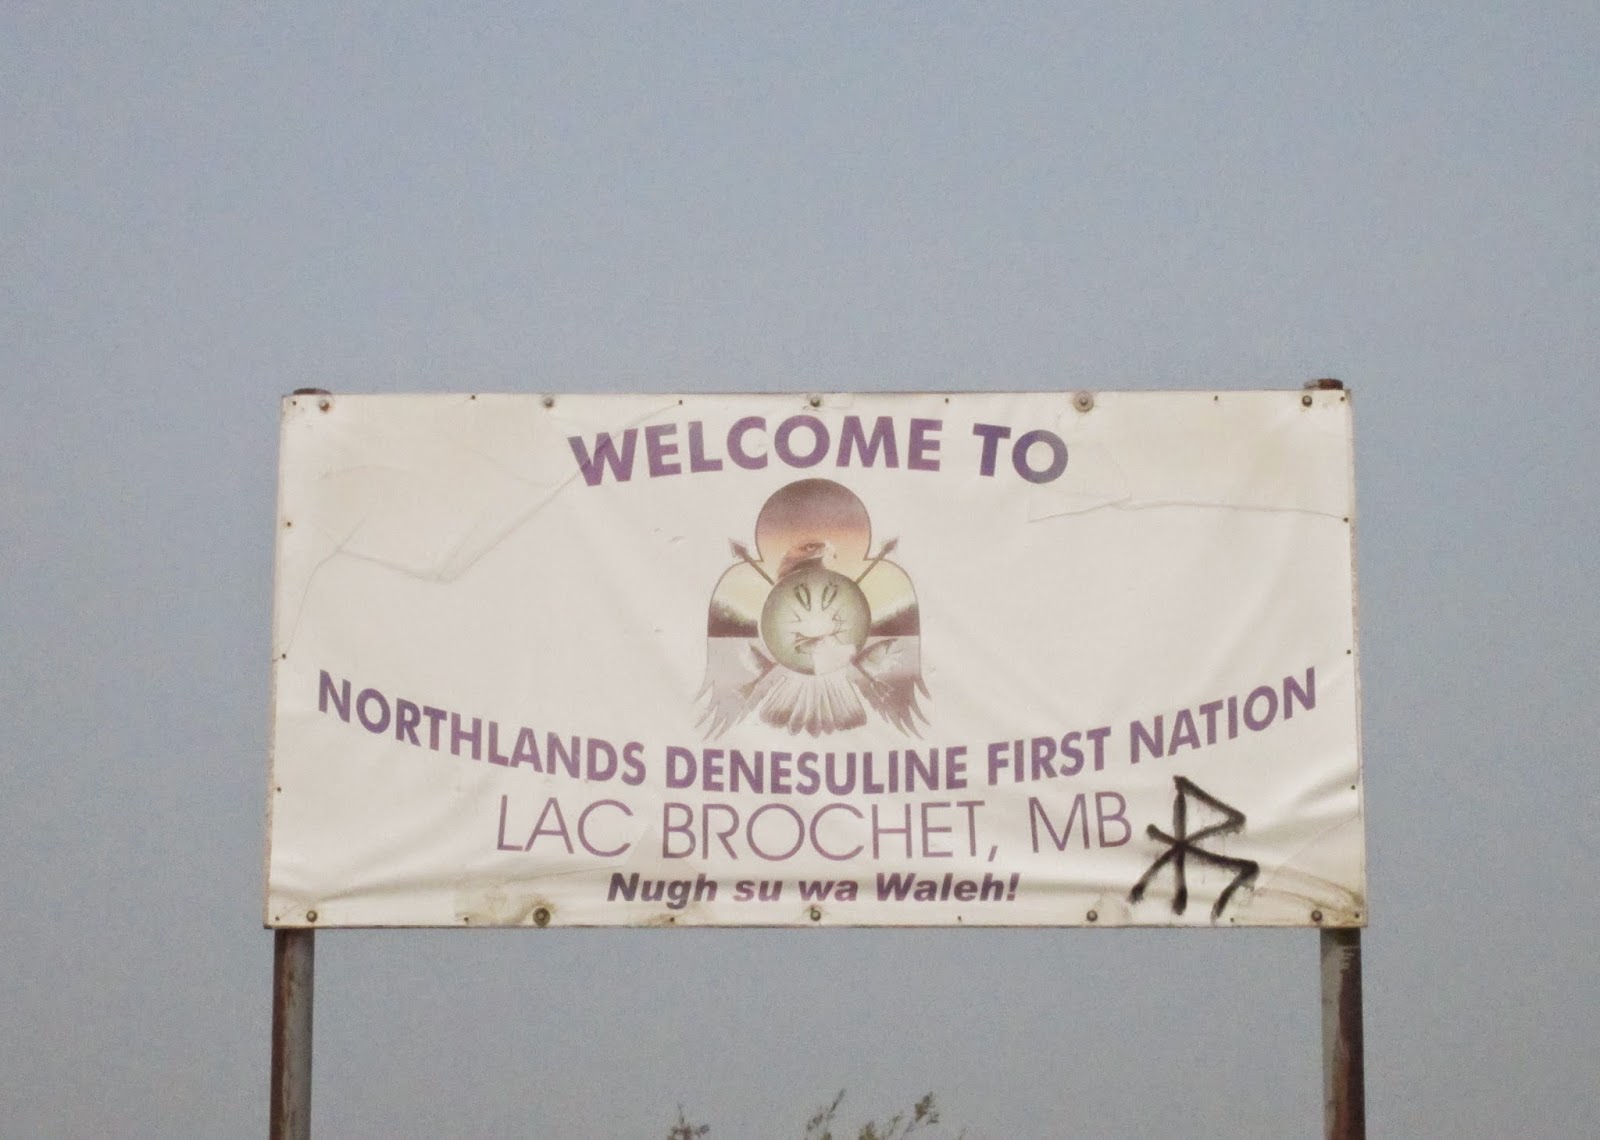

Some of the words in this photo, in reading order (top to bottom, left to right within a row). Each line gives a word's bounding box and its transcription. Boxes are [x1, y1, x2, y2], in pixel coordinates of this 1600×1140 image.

[568, 415, 943, 486] WELCOME
[973, 423, 1069, 484] TO
[318, 669, 647, 786] NORTHLANDS
[664, 745, 969, 796] DENESULINE
[987, 726, 1112, 786] FIRST
[1129, 666, 1317, 764] NATION
[496, 794, 634, 857] LAC
[661, 799, 999, 863] BROCHET,
[1027, 791, 1133, 854] MB
[607, 872, 718, 910] Nugh
[733, 880, 783, 902] su
[799, 880, 859, 902] wa
[875, 872, 1021, 902] Waleh!
